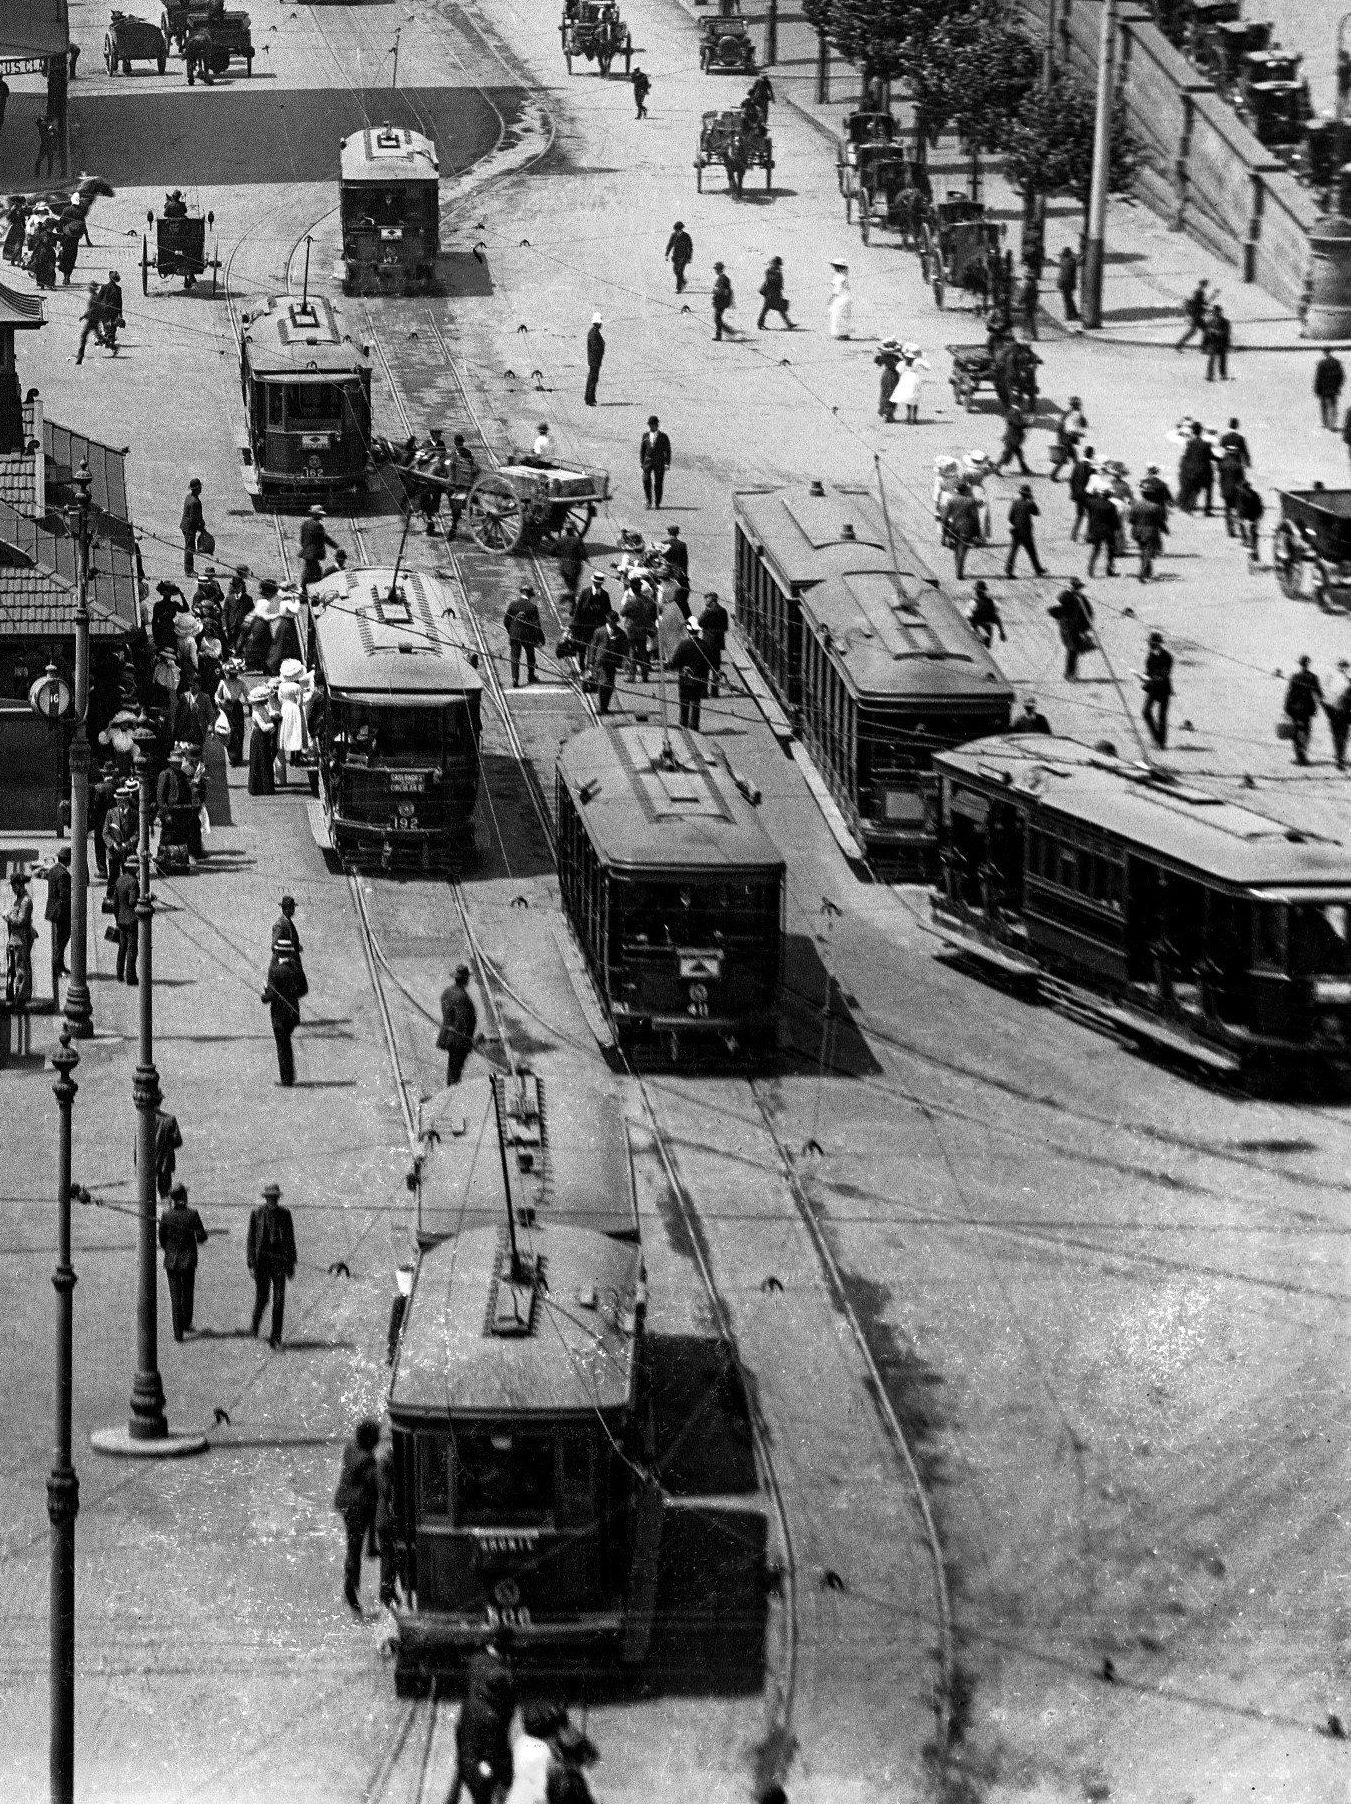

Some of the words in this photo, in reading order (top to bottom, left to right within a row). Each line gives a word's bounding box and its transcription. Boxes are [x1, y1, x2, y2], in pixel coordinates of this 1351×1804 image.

[303, 467, 324, 478] 162
[48, 693, 60, 704] 16
[392, 815, 418, 830] 192
